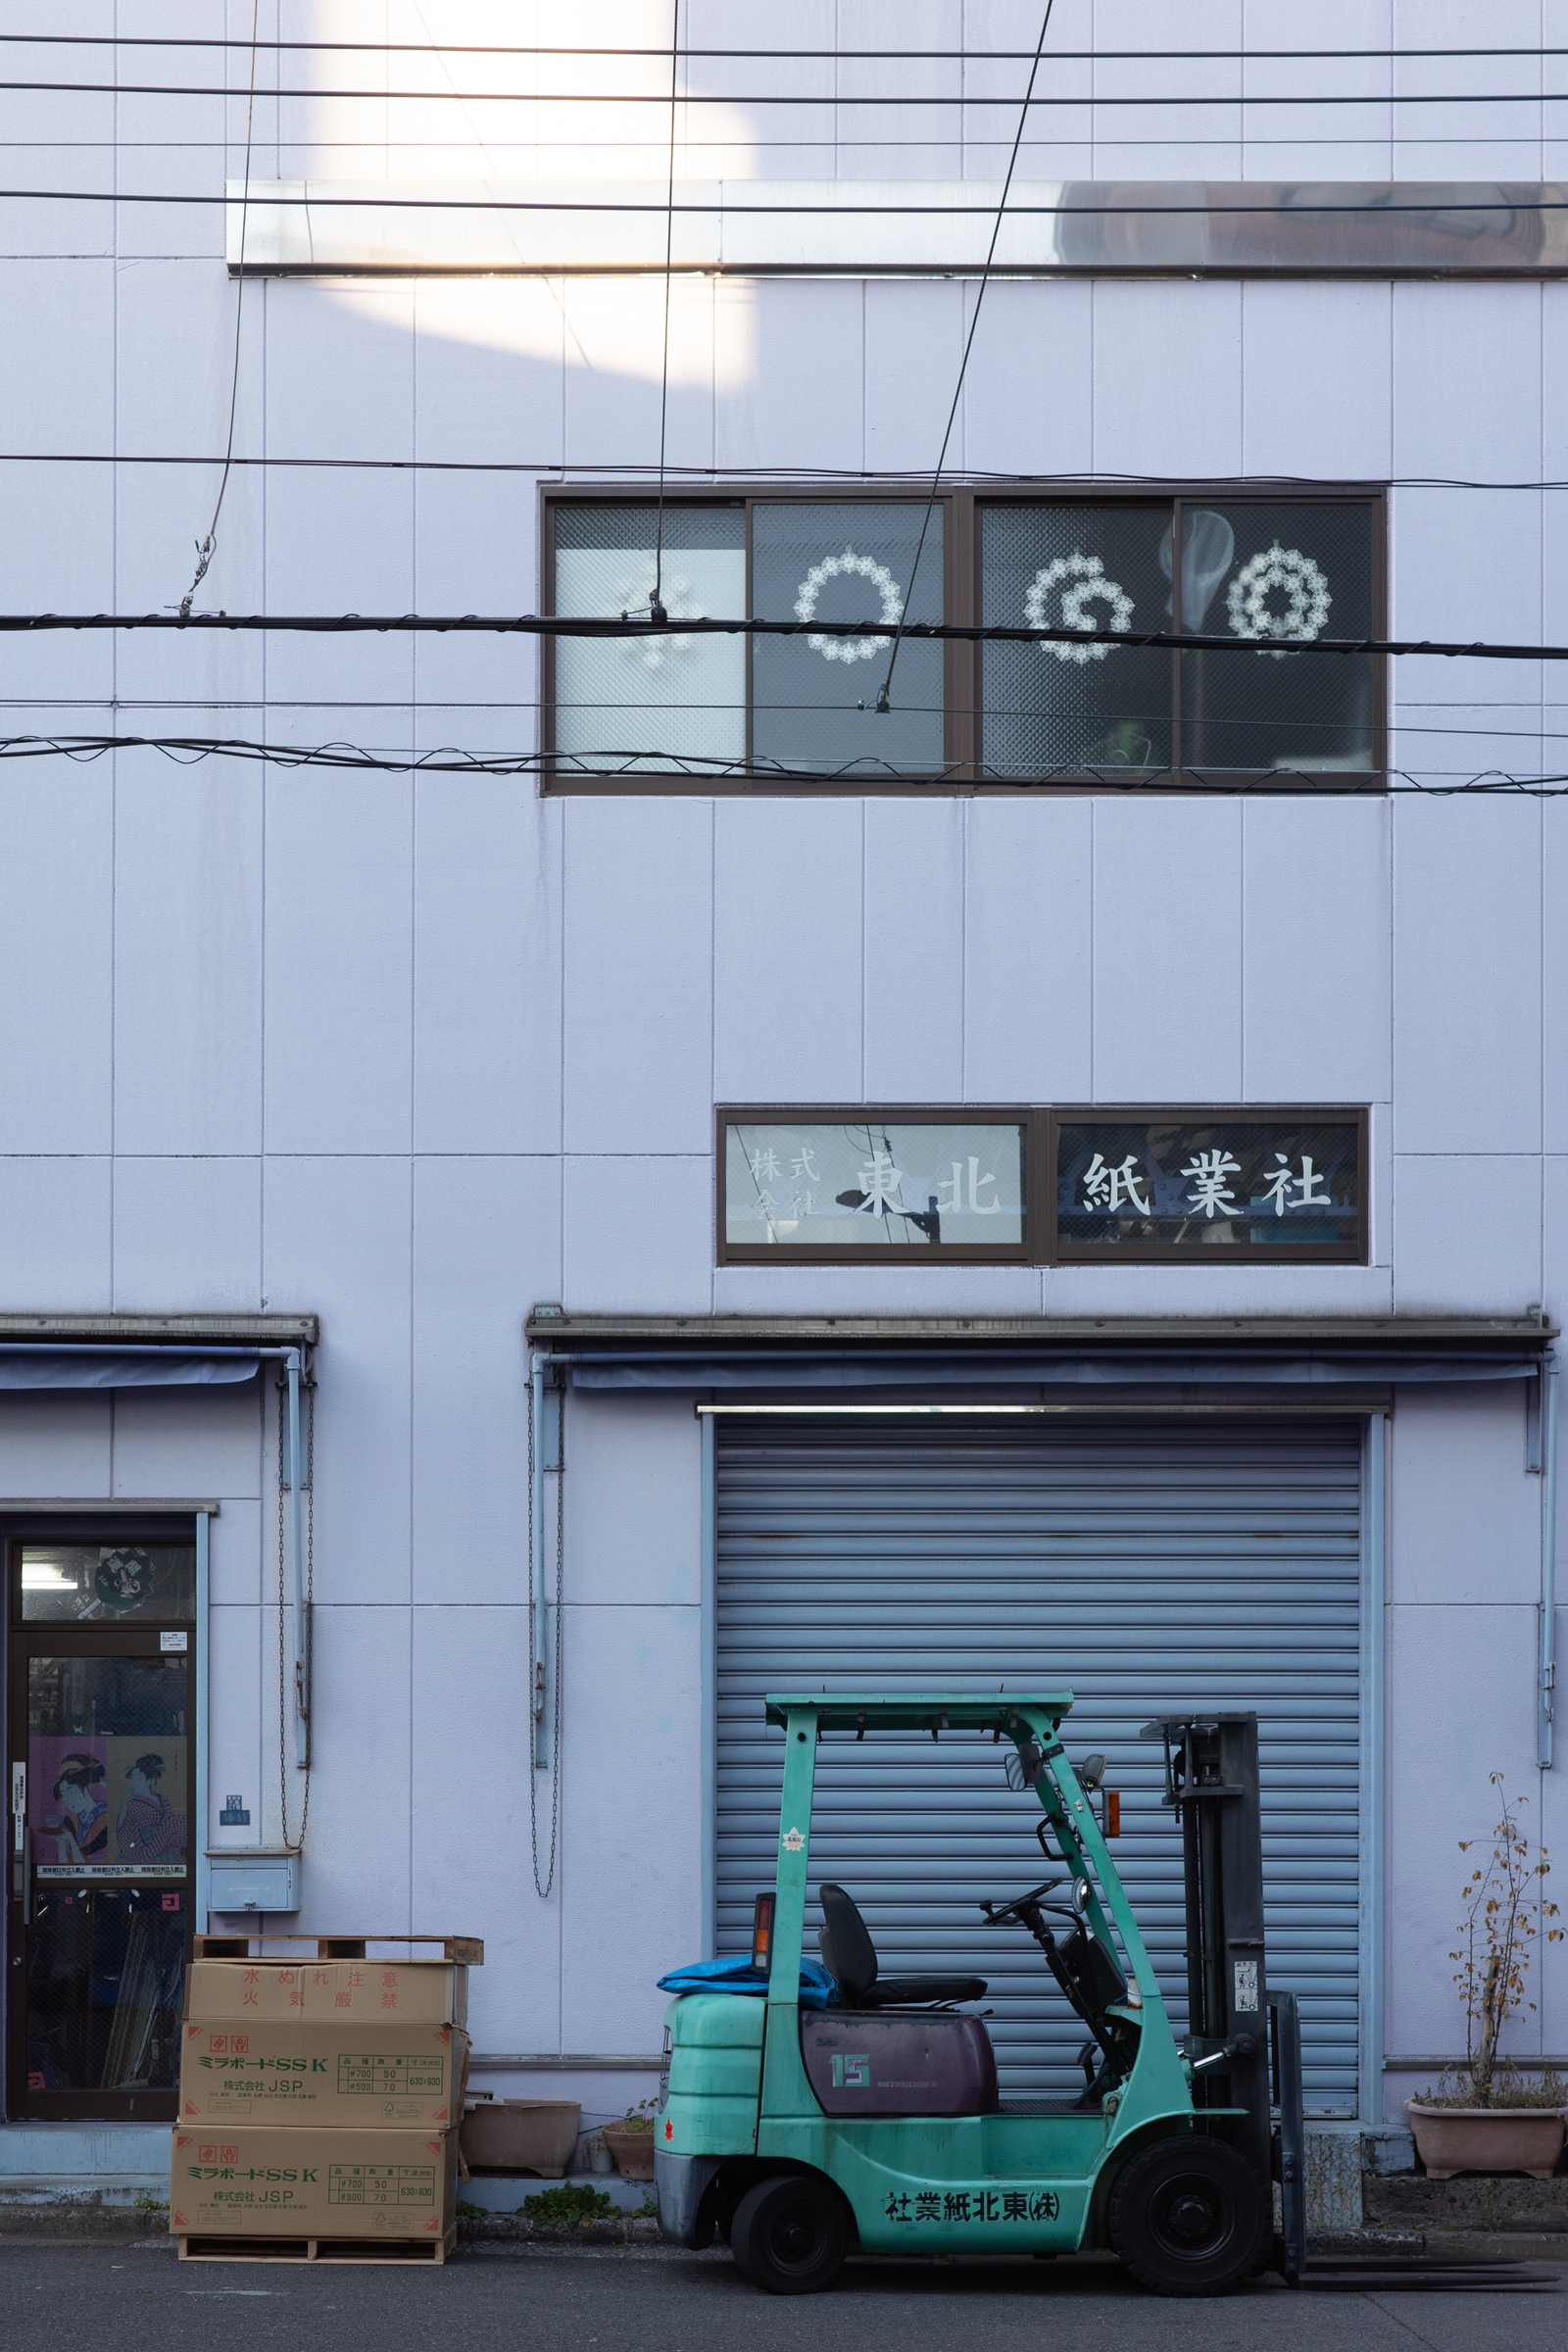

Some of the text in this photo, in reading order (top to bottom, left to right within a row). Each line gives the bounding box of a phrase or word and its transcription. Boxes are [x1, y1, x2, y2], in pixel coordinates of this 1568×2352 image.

[749, 1147, 820, 1182] 株式
[751, 1189, 821, 1221] 会社
[244, 1968, 399, 1987] 水ぬれ注意
[243, 1989, 398, 2008] 火気厳禁
[829, 2054, 870, 2087] 15
[223, 2080, 303, 2092] 株式会社 JSP
[214, 2190, 294, 2202] 株式会社 JSP
